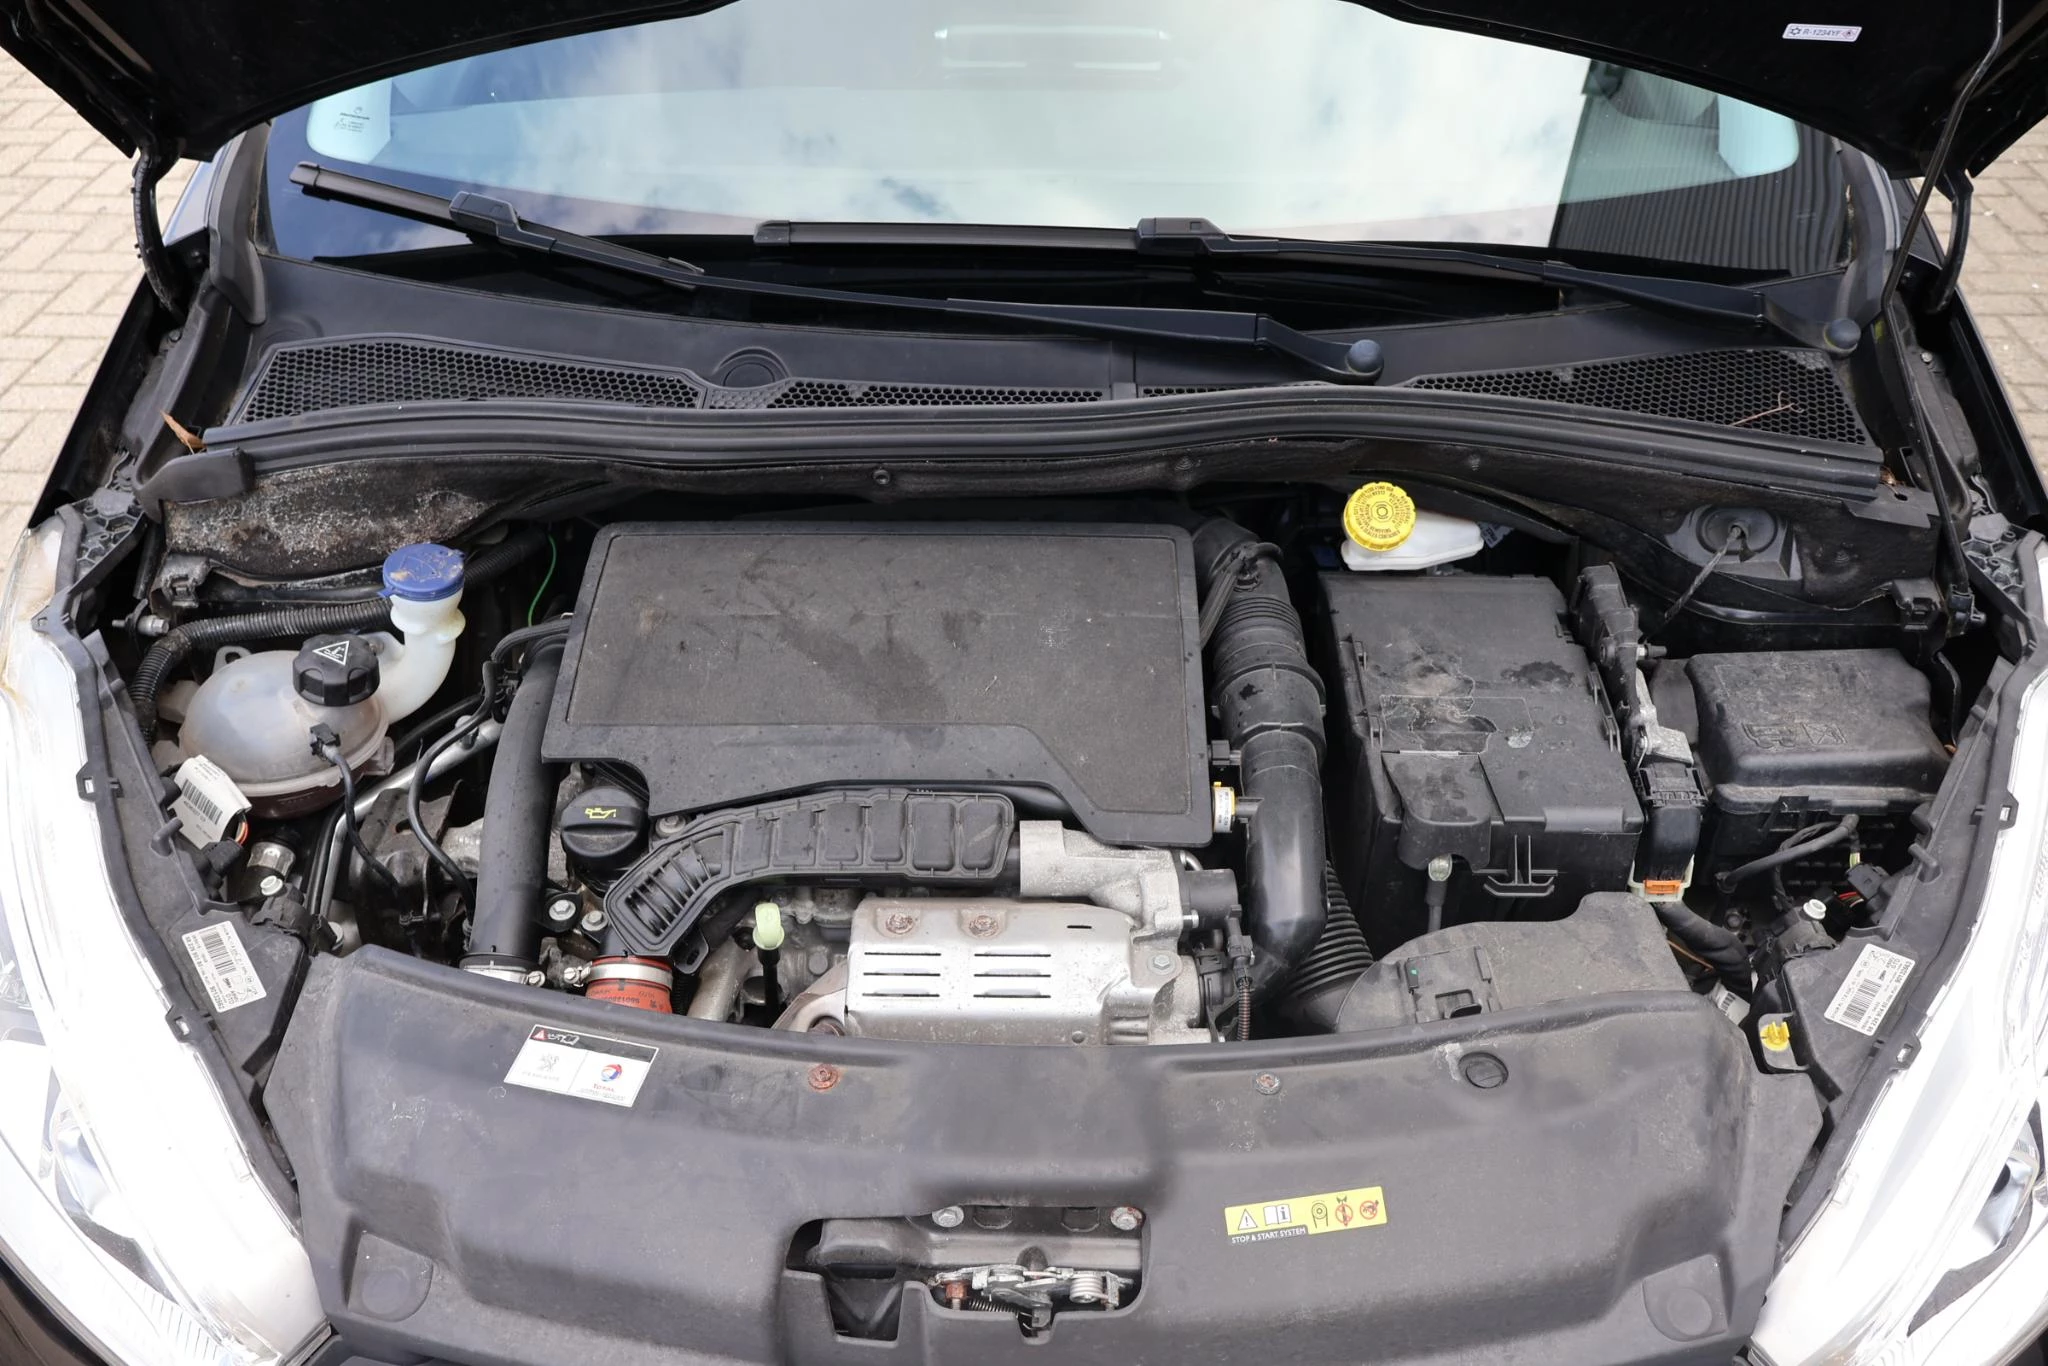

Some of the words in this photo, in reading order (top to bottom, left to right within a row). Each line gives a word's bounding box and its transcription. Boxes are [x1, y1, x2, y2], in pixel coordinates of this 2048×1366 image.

[1231, 1235, 1249, 1244] STOP
[1257, 1230, 1279, 1241] START
[1279, 1226, 1306, 1238] SYSTEM
